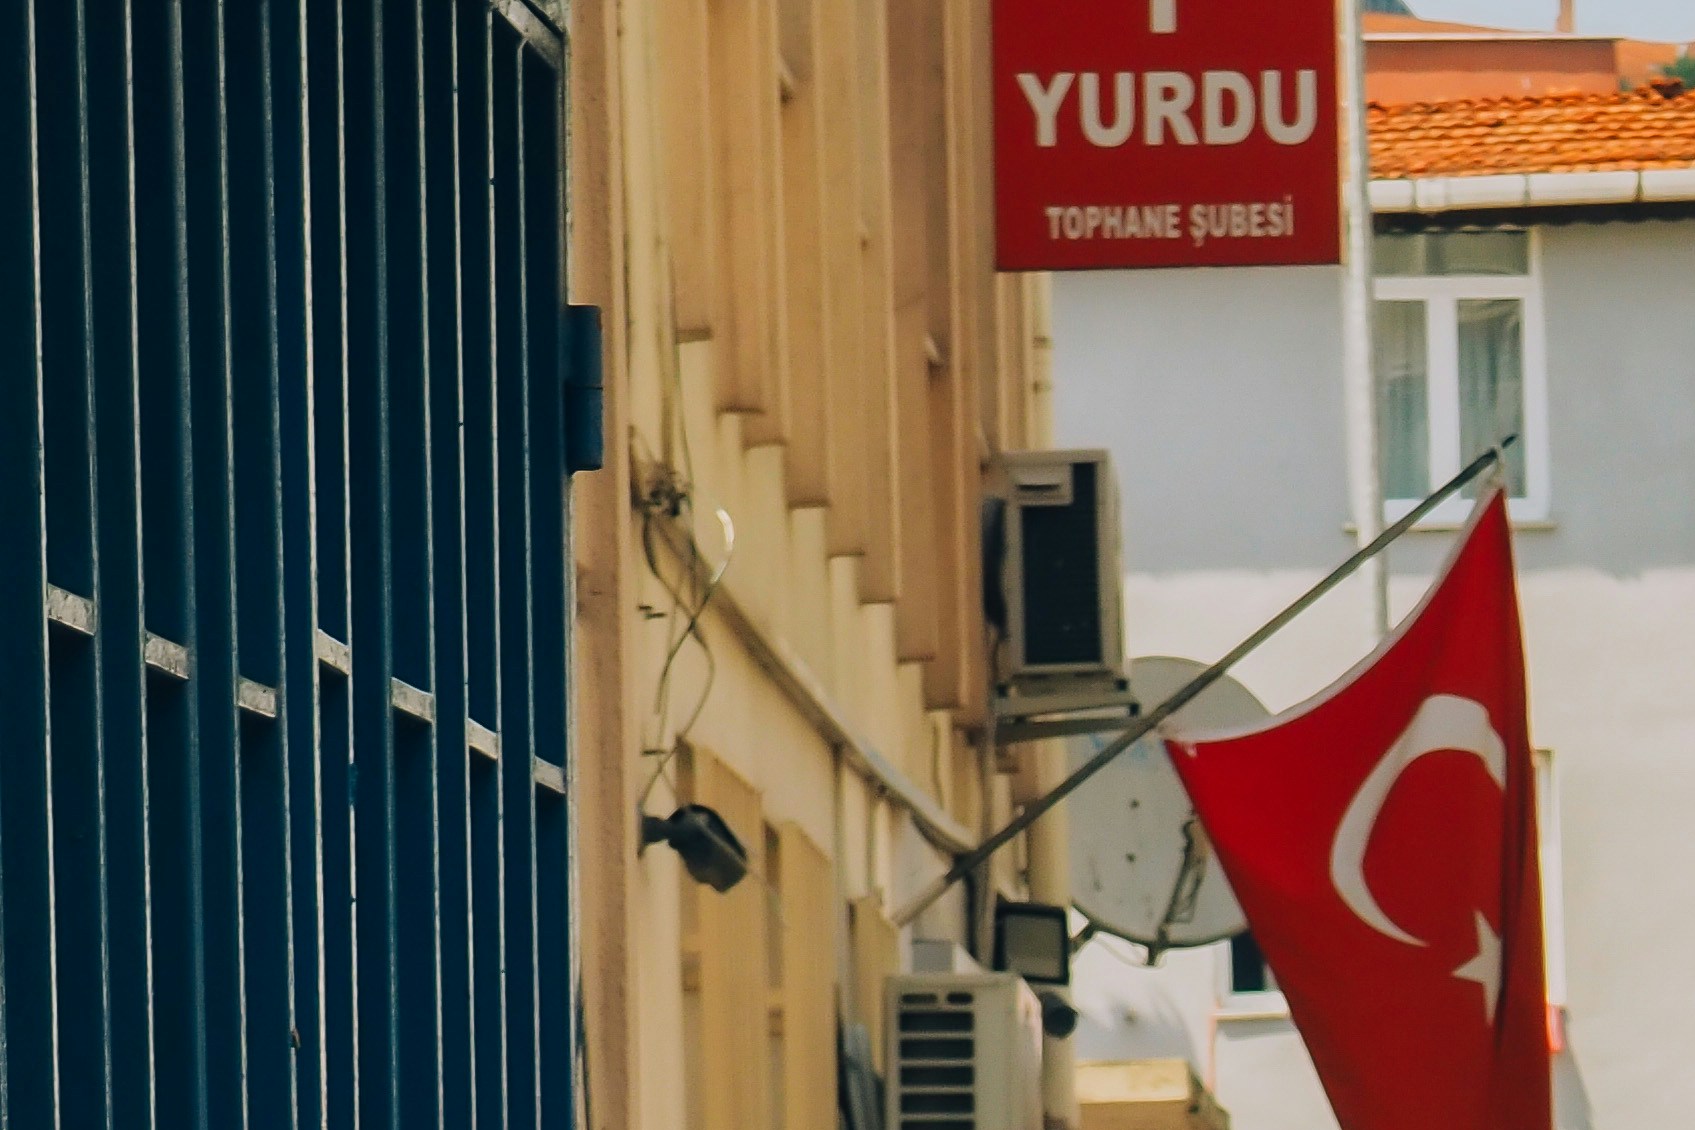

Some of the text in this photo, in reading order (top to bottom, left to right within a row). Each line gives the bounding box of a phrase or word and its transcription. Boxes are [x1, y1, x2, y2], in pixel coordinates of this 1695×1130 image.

[1015, 69, 1318, 148] YURDU
[1044, 195, 1294, 247] TOPHANE ŞUBESİ
